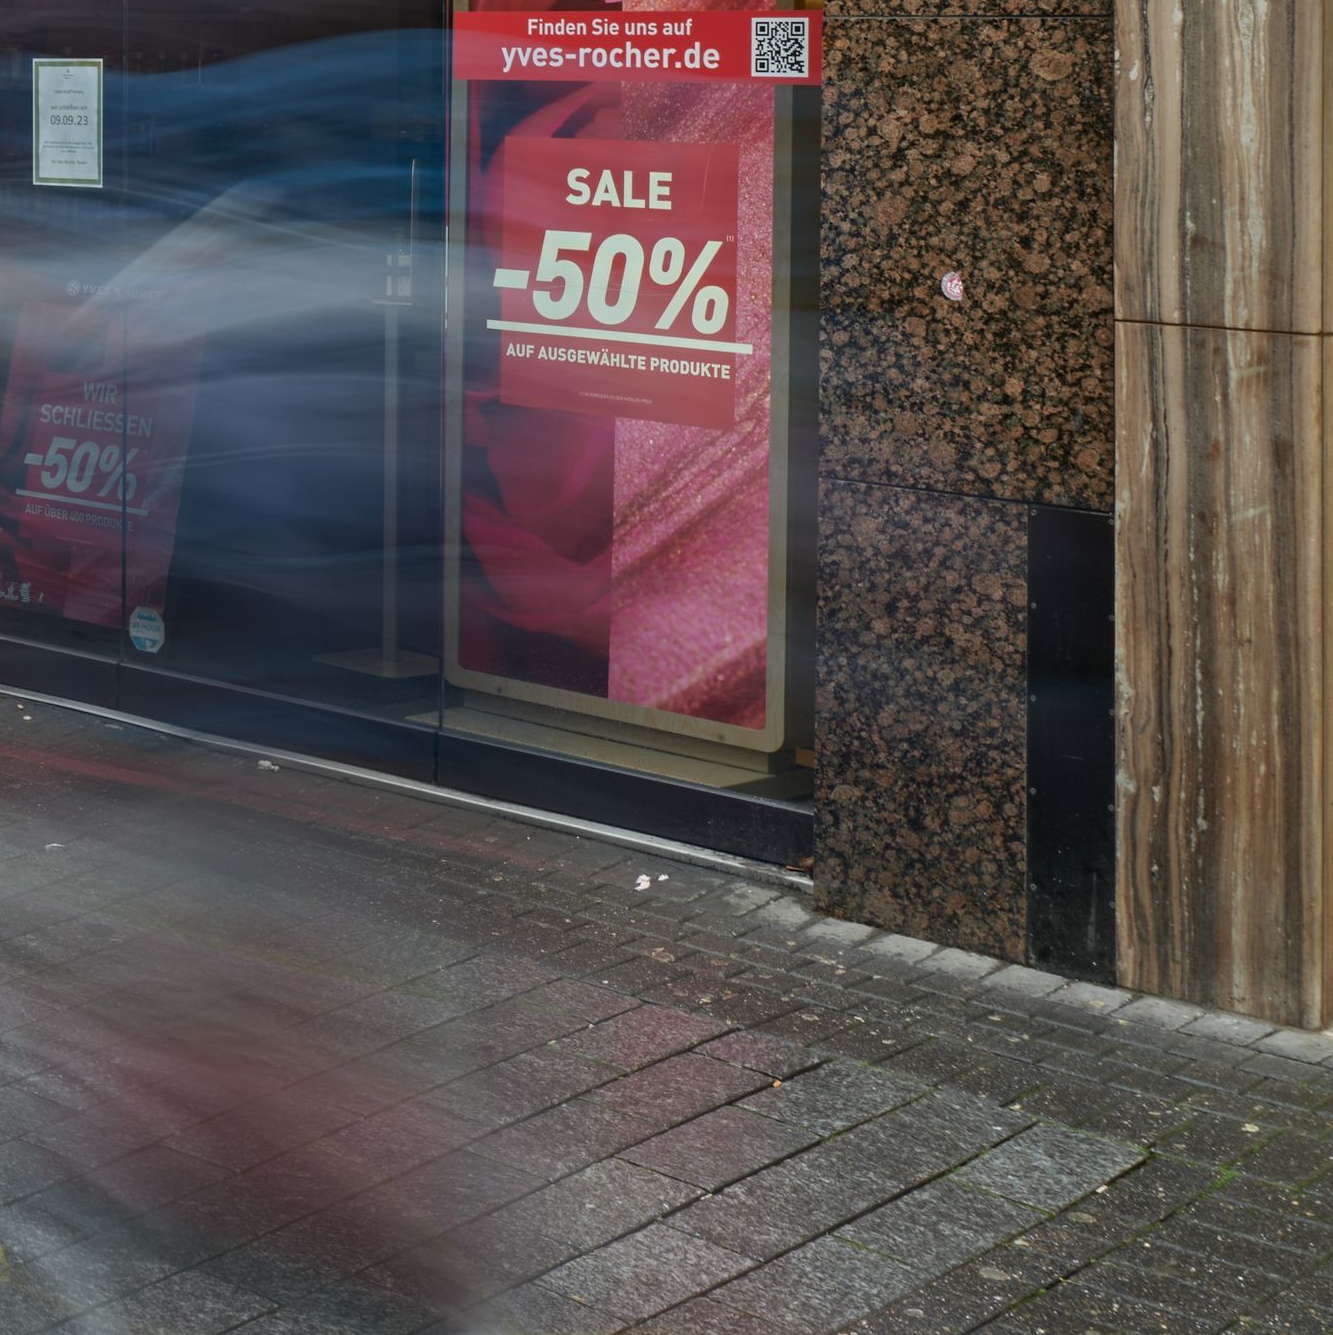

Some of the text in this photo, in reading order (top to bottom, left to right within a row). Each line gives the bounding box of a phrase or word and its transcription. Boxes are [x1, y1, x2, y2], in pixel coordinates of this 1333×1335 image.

[527, 18, 693, 36] Finden Sie uns auf
[501, 41, 720, 73] yves-rocher.de
[50, 114, 89, 126] 09.09.23
[565, 168, 673, 210] SALE
[493, 229, 730, 335] -50%
[506, 343, 731, 380] AUF AUSGEWÄHLTE PRODUKTE
[83, 381, 118, 405] WIR
[40, 404, 153, 438] SCHLIESSEN
[23, 436, 140, 502] -50%
[25, 503, 42, 516] AUF
[44, 503, 68, 520] ÜBER
[68, 511, 84, 523] 400
